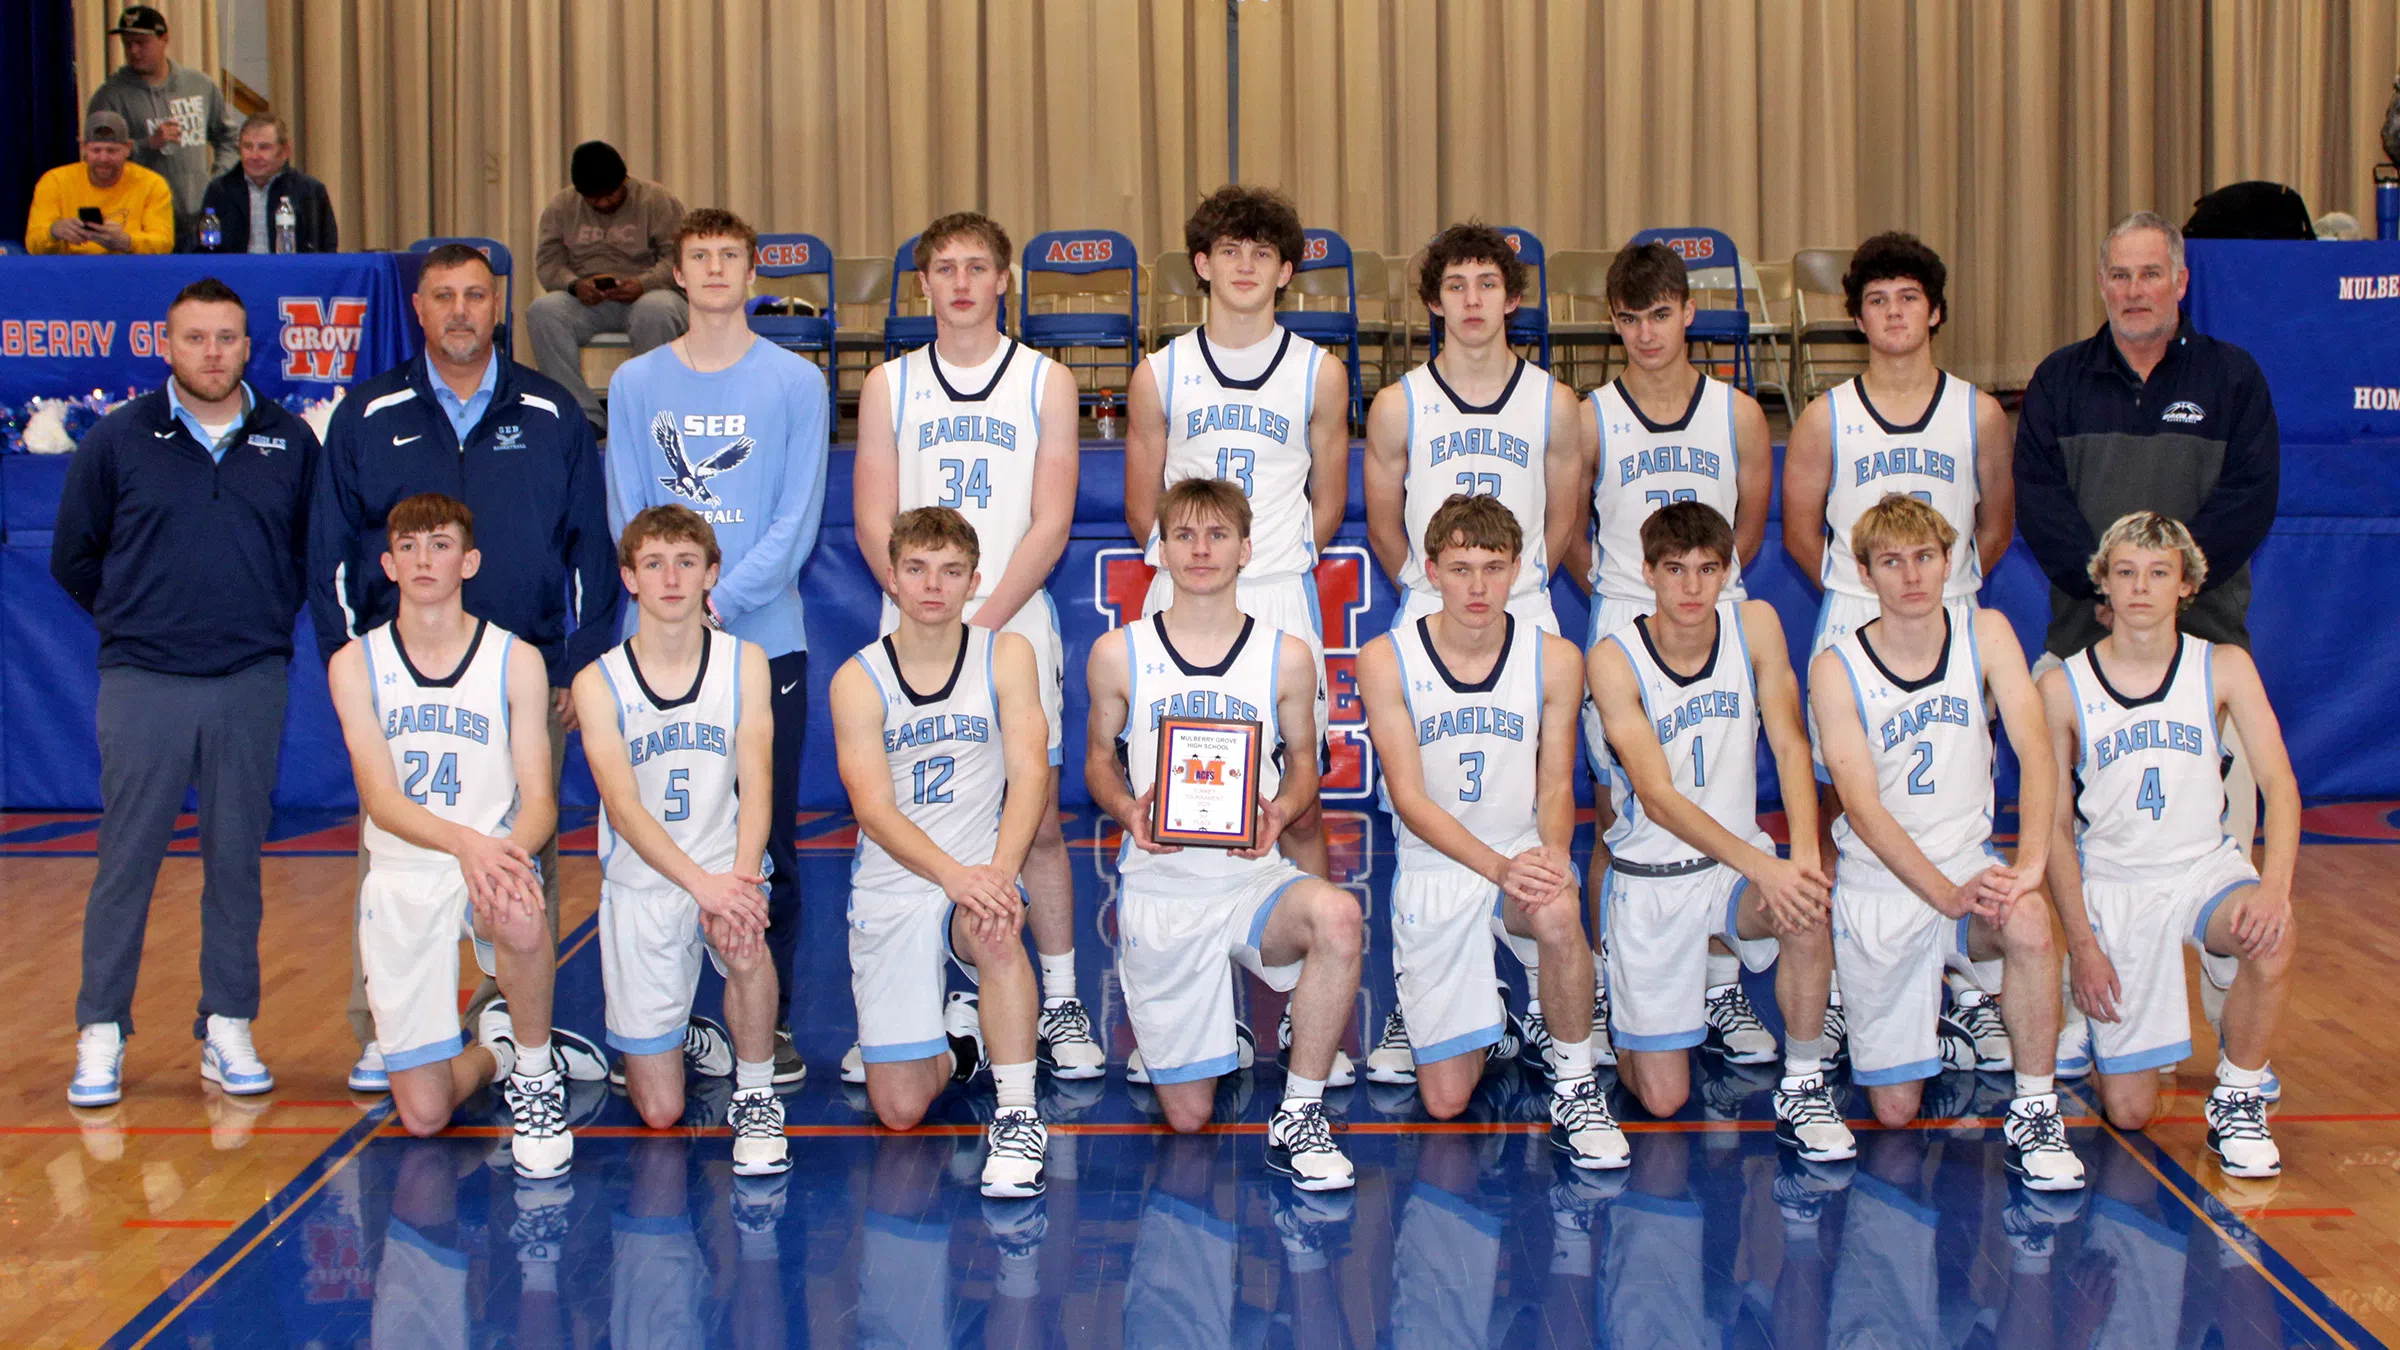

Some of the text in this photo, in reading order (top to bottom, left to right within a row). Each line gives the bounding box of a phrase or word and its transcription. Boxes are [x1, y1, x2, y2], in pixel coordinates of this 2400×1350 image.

[146, 112, 206, 136] NRTH
[168, 96, 204, 114] THE
[1045, 240, 1113, 263] ACES
[1654, 237, 1714, 261] CES
[0, 320, 116, 358] BERRY
[684, 414, 746, 436] SEB
[919, 415, 1017, 451] EAGLES
[1187, 404, 1290, 445] EAGLES
[1430, 428, 1530, 469] EAGLES
[1619, 446, 1720, 487] EAGLES
[1854, 447, 1955, 487] EAGLES
[939, 458, 992, 509] 34
[1216, 447, 1256, 499] 13
[385, 703, 490, 745] EAGLES
[1150, 690, 1258, 733] EAGLES
[1419, 706, 1524, 747] EAGLES
[1657, 689, 1740, 745] EAGLES
[1880, 694, 1969, 753] EAGLES
[630, 722, 727, 767] EAGLES
[883, 714, 989, 753] EAGLES
[1180, 735, 1215, 743] MULBERRY
[1203, 743, 1230, 751] SCHOOL
[2094, 720, 2202, 771] EAGLES
[404, 750, 462, 806] 24
[912, 755, 955, 805] 12
[1195, 770, 1215, 780] ACES
[1459, 750, 1485, 802] 3
[1691, 735, 1705, 787] 1
[1907, 741, 1935, 795] 2
[664, 768, 690, 822] 5
[2136, 766, 2166, 821] 4
